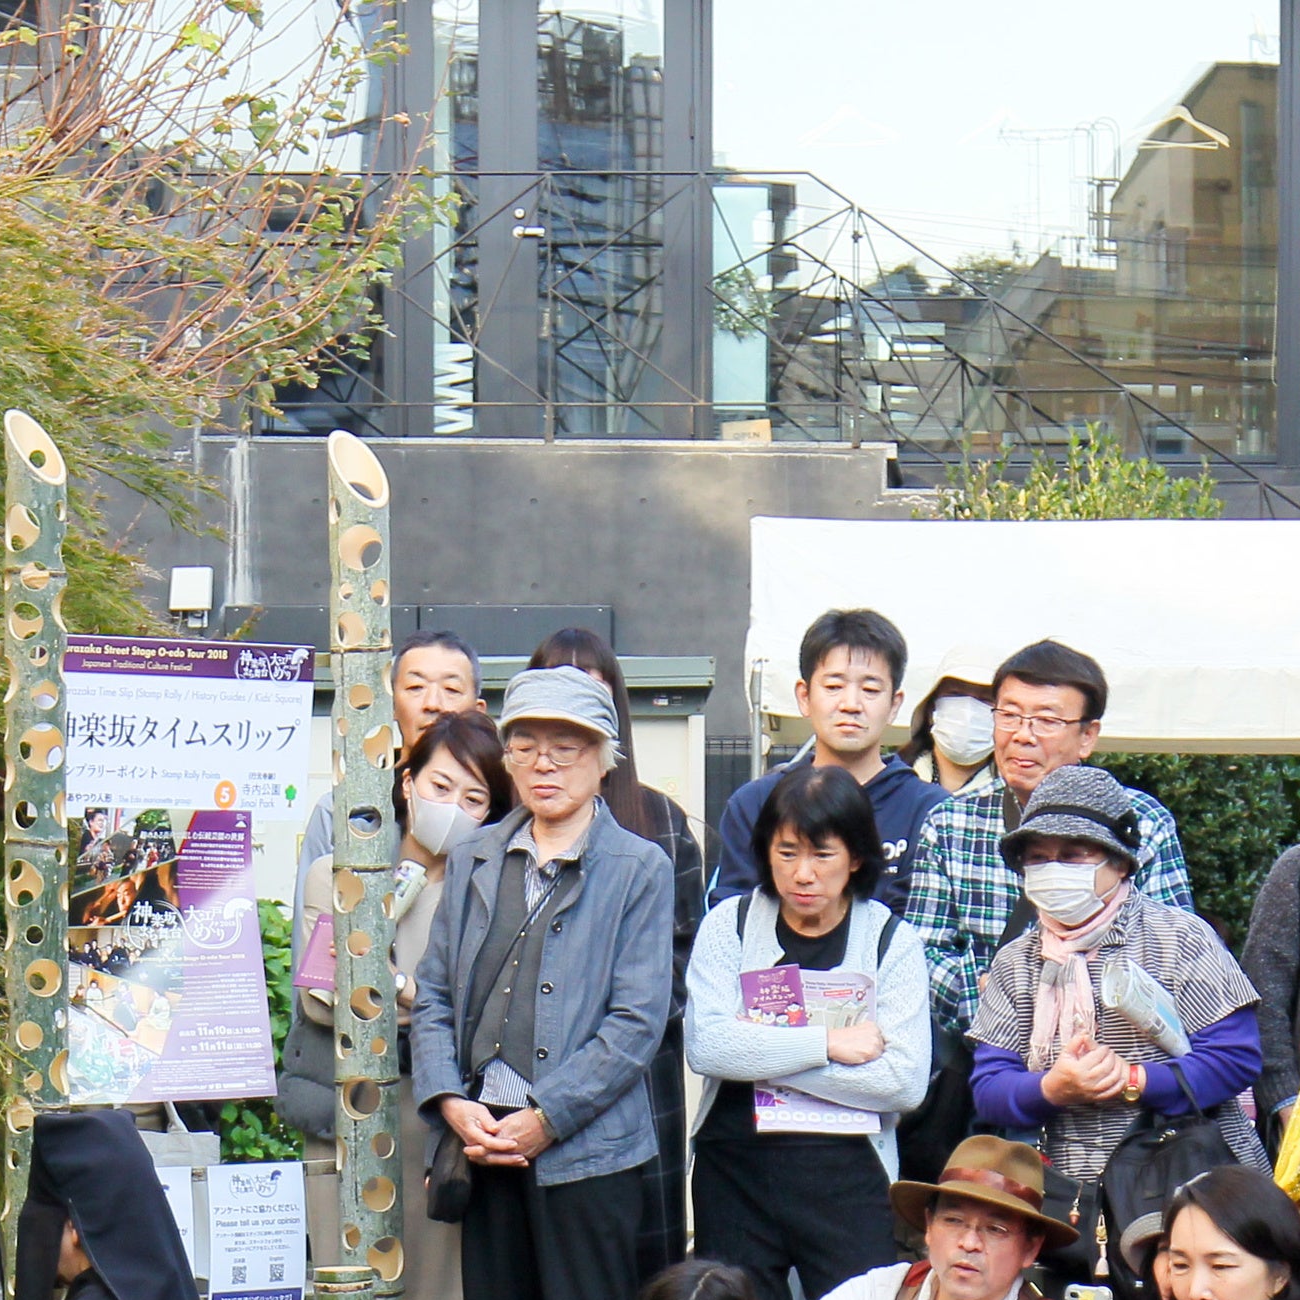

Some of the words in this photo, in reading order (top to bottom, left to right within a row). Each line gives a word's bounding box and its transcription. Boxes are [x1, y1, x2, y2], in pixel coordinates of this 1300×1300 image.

[103, 644, 130, 655] Street
[131, 646, 156, 658] Stage
[157, 647, 186, 658] O-edo
[186, 648, 206, 659] Tour
[207, 649, 228, 660] 2018
[81, 659, 112, 669] Japanese
[113, 660, 146, 669] Traditional
[147, 661, 169, 671] Culture
[170, 662, 193, 671] Festival
[98, 686, 117, 697] Time
[118, 687, 134, 700] Slip
[164, 689, 183, 702] Rally
[191, 691, 218, 704] History
[219, 692, 246, 702] Guides
[161, 769, 183, 781] Stamp
[184, 770, 200, 782] Rally
[219, 786, 231, 803] 5
[242, 783, 281, 796] 寺内公園
[259, 798, 276, 808] Park
[132, 900, 178, 927] 神楽坂
[215, 1219, 238, 1227] Please
[239, 1219, 250, 1227] tell
[261, 1219, 275, 1228] your
[277, 1217, 300, 1226] opinion
